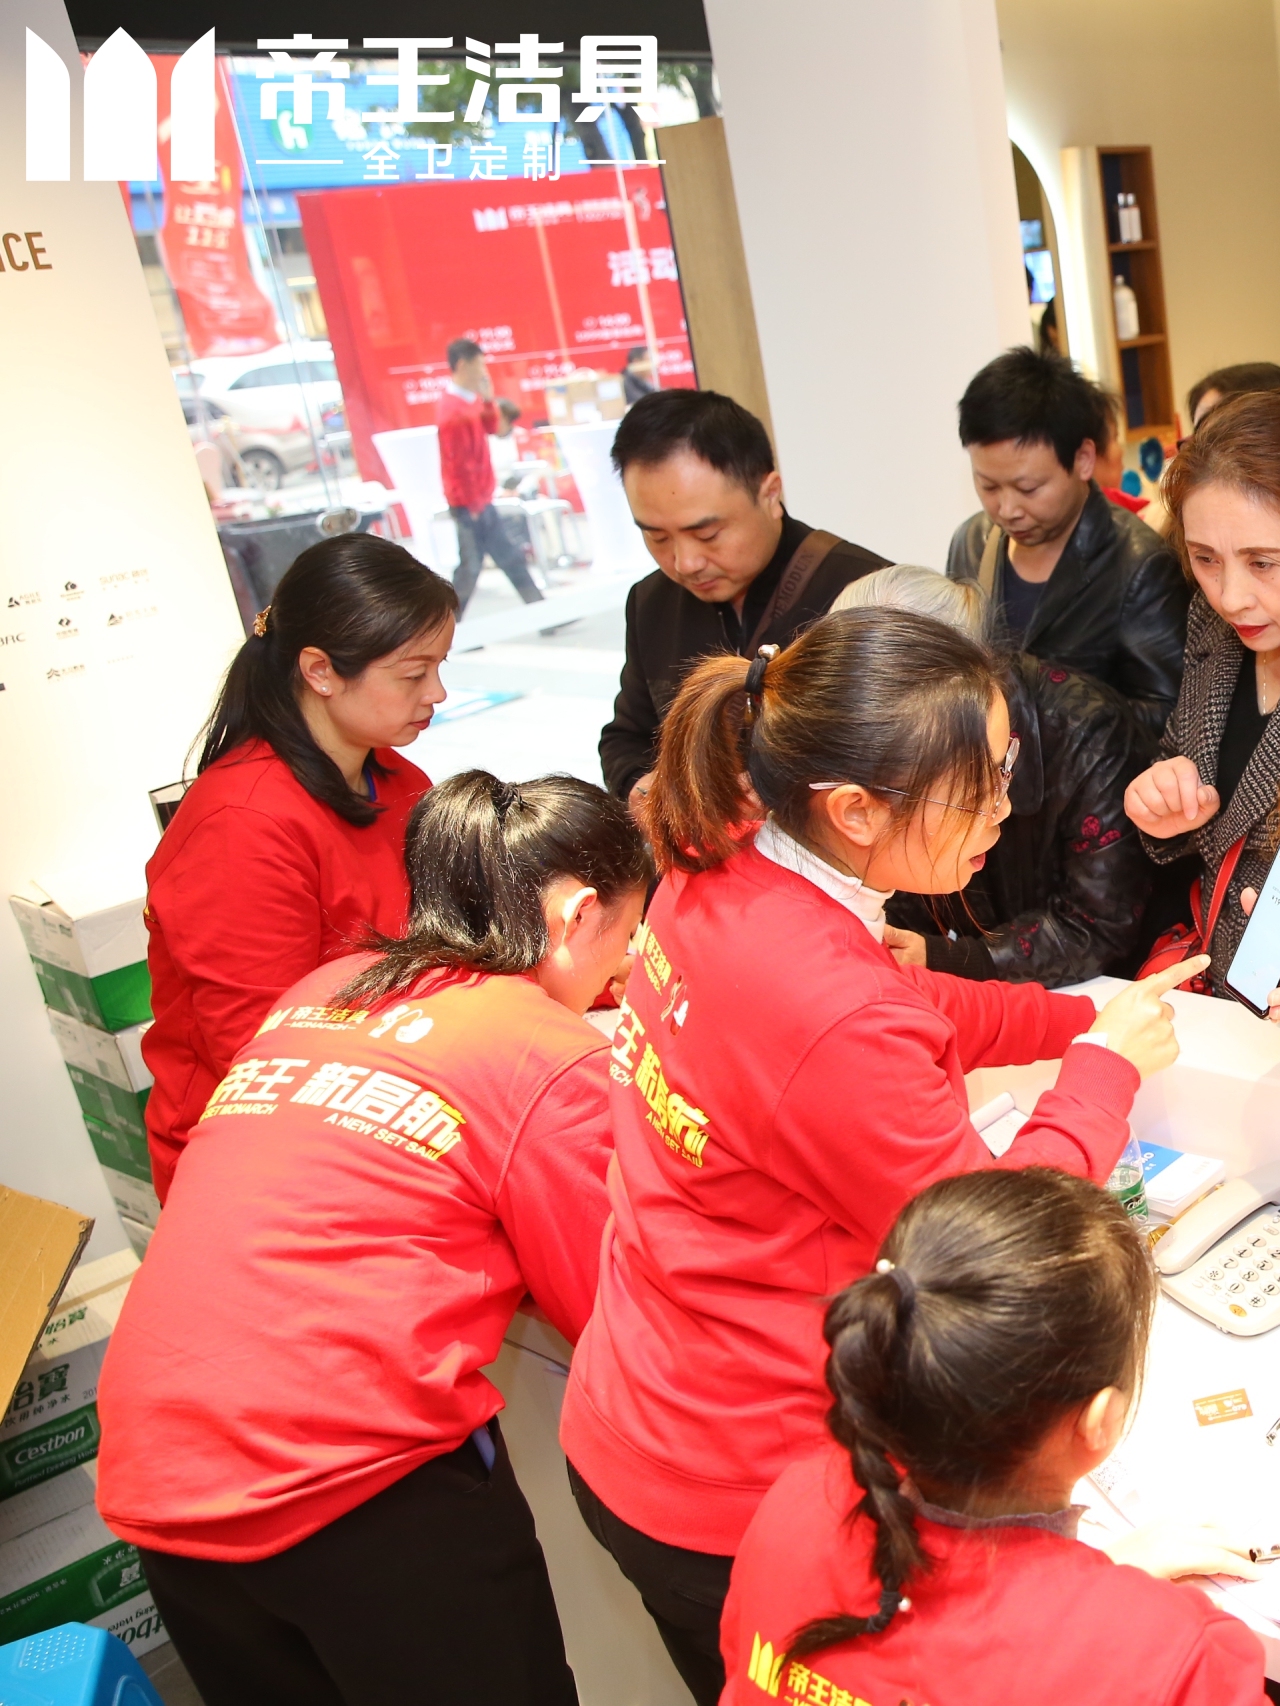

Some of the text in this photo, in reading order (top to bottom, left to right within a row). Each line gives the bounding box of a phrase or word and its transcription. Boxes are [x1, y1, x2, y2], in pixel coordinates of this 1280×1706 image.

[0, 231, 53, 273] CE
[290, 1006, 369, 1024] 帝王洁具
[290, 1021, 348, 1031] MONARCH
[218, 1103, 279, 1115] MONARCH
[323, 1112, 339, 1125] A
[335, 1113, 377, 1136] NEW
[373, 1128, 408, 1148] SET
[1251, 1238, 1261, 1247] 1
[1257, 1259, 1269, 1271] 5
[1223, 1258, 1275, 1294] 7 8 9
[1229, 1282, 1240, 1291] 0
